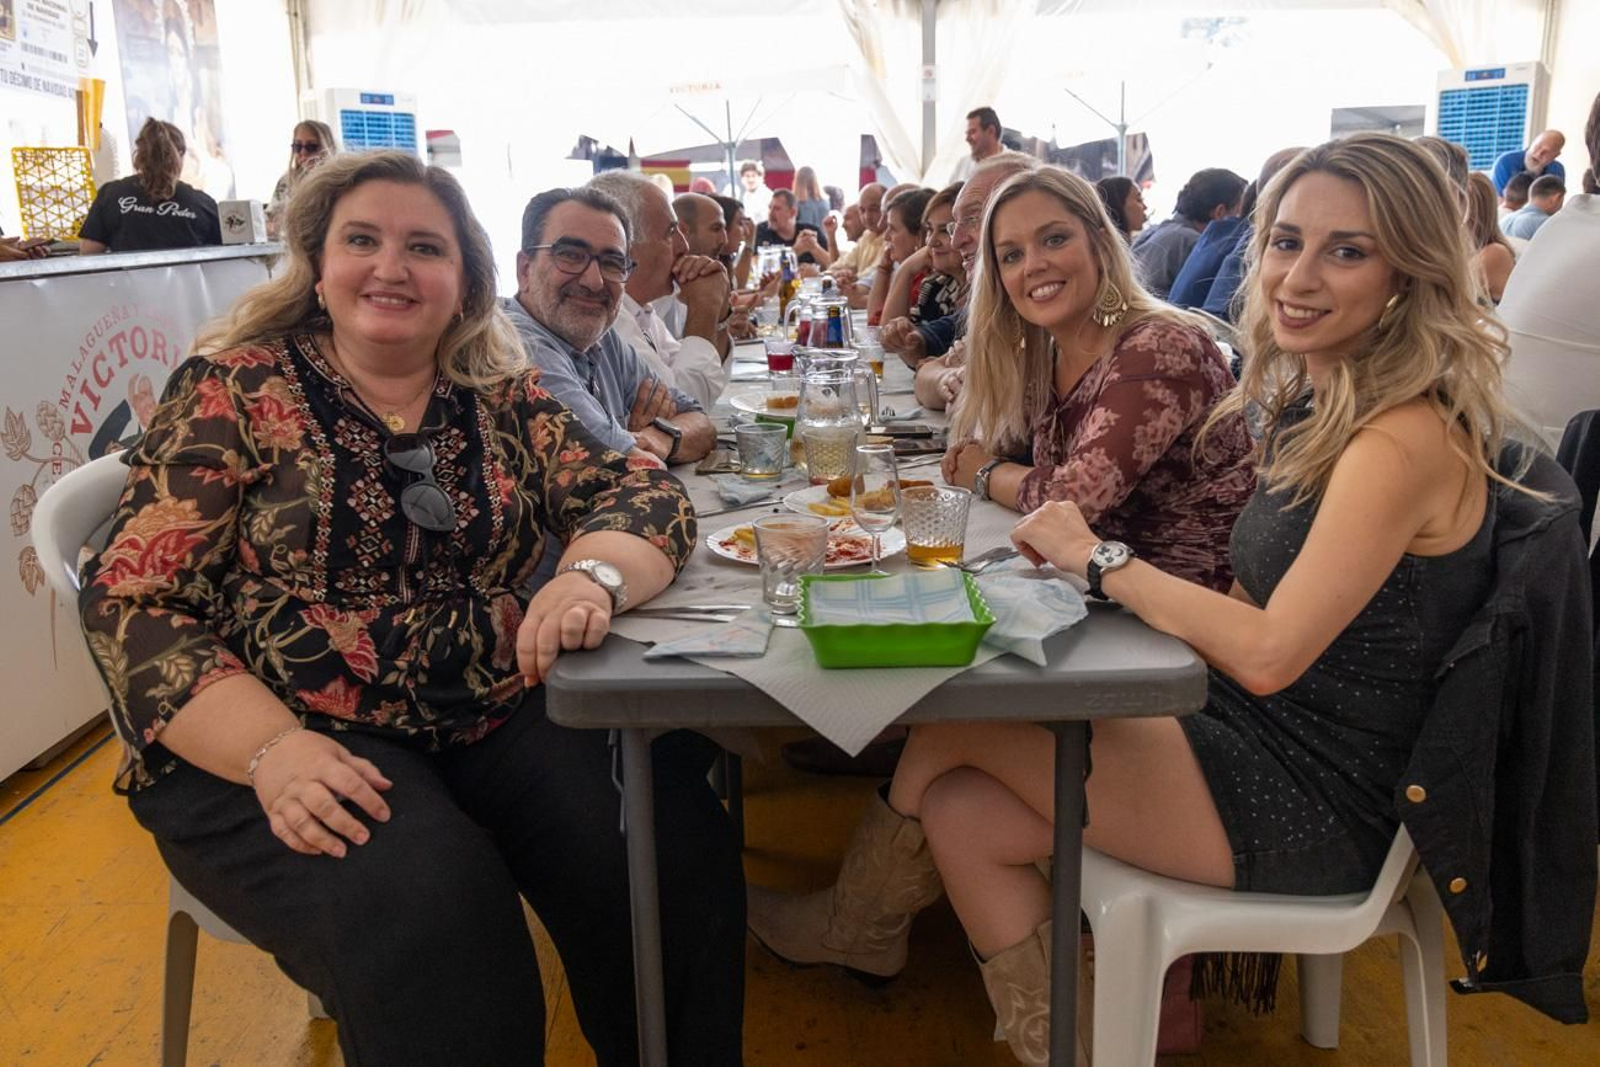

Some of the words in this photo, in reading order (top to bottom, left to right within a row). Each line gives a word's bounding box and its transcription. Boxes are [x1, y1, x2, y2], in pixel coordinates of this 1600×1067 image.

[117, 196, 155, 214] Gran
[156, 201, 197, 219] Poder
[58, 304, 130, 410] MALAGUEÑA
[70, 325, 182, 437] VICTORI
